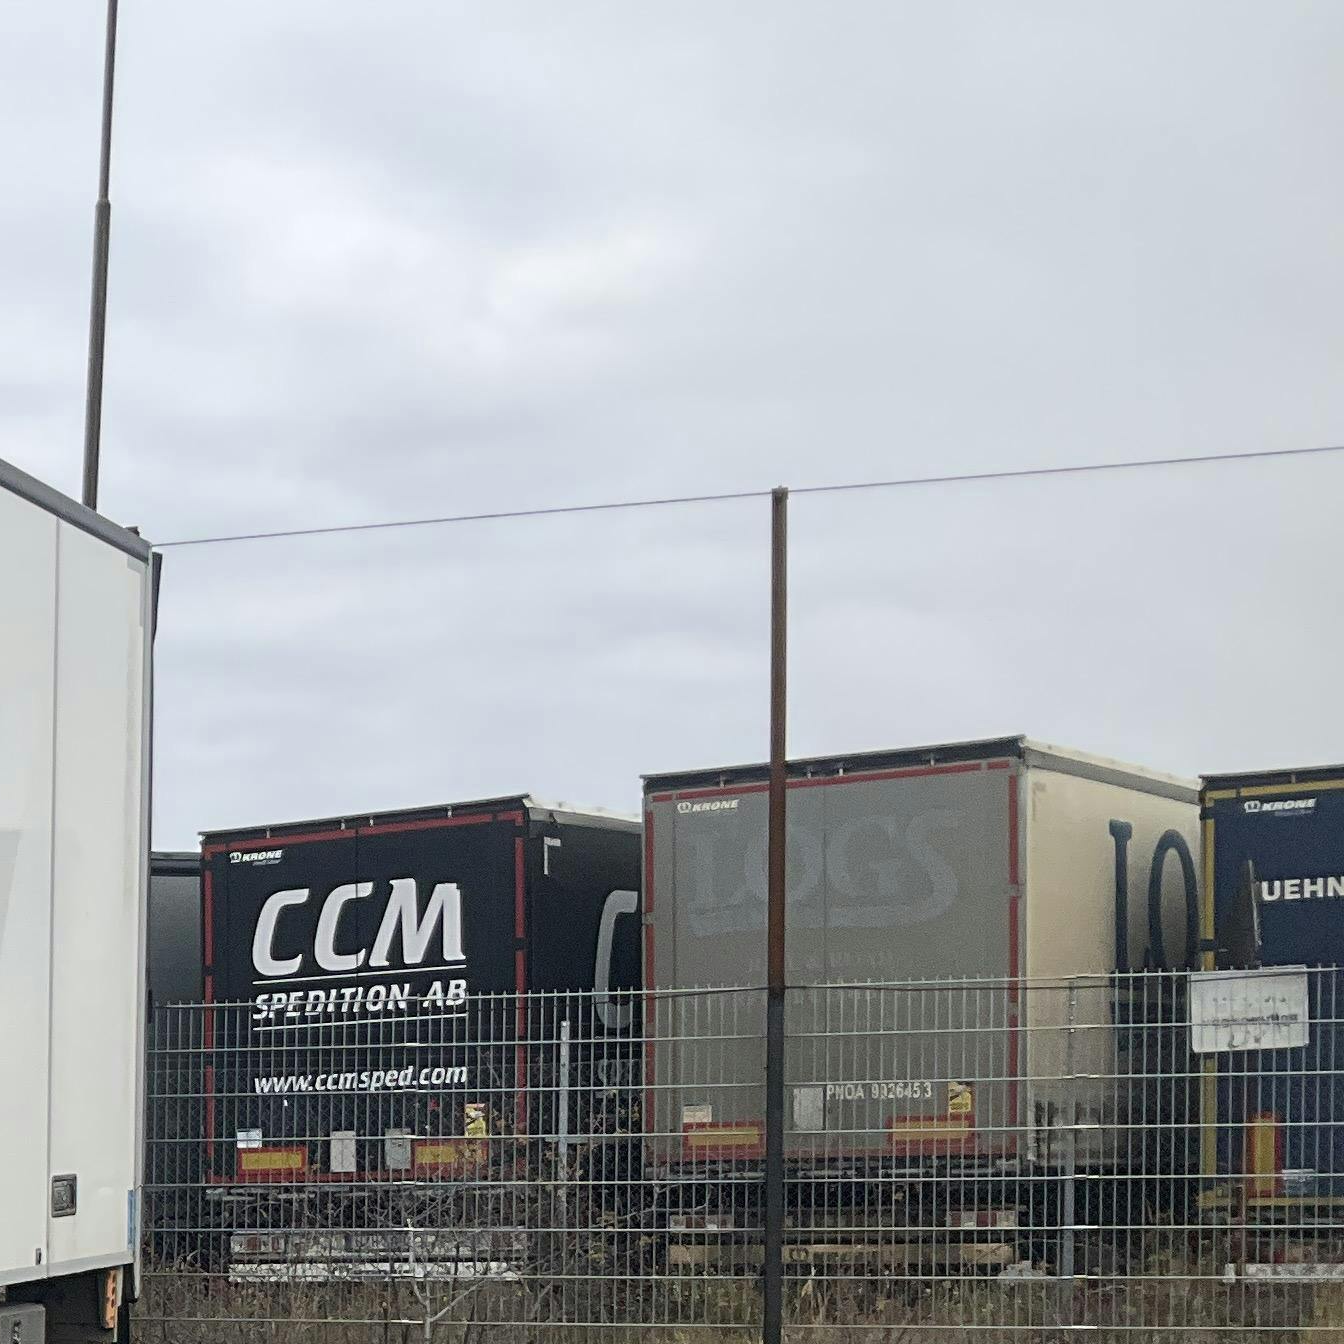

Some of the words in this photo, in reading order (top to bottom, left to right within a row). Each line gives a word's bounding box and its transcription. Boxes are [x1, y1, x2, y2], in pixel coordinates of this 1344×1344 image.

[692, 799, 740, 811] KRONE
[1262, 797, 1317, 811] KRONE
[242, 849, 283, 861] KRONE
[252, 877, 467, 977] CCM
[252, 983, 410, 1020] SPEDITION
[423, 979, 467, 1007] AB
[254, 1065, 467, 1094] www.ccmsped.com
